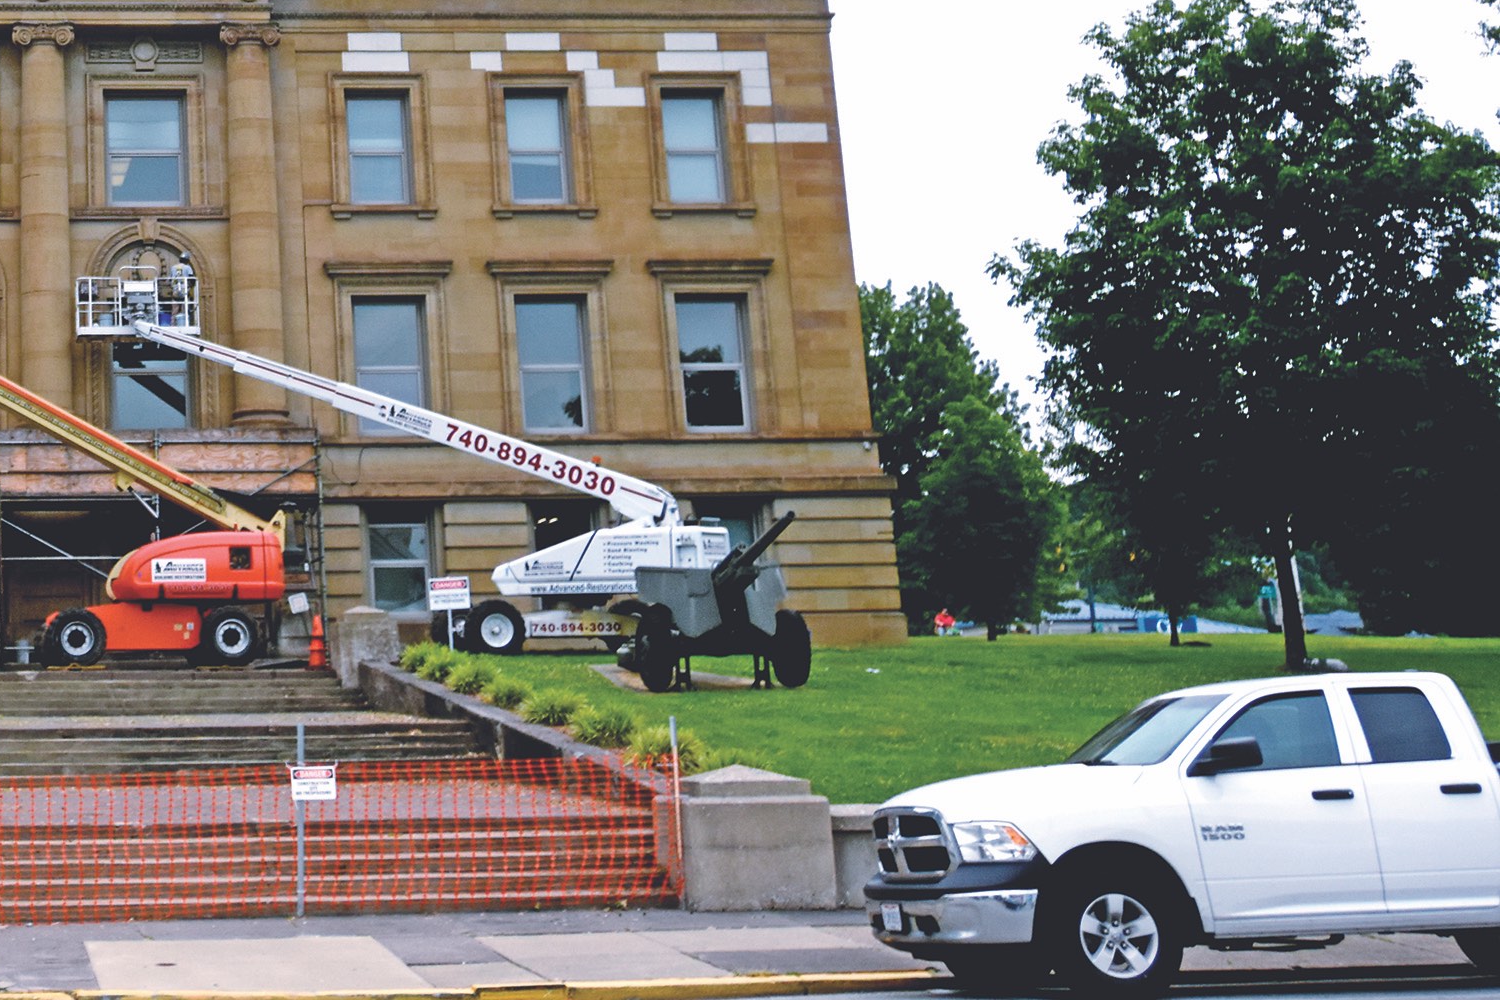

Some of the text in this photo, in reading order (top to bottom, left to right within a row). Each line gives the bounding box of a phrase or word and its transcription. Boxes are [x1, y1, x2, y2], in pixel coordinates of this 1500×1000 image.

[446, 423, 615, 495] 740-894-3030
[533, 622, 621, 633] 740-894-3030
[1202, 832, 1245, 841] 1500
